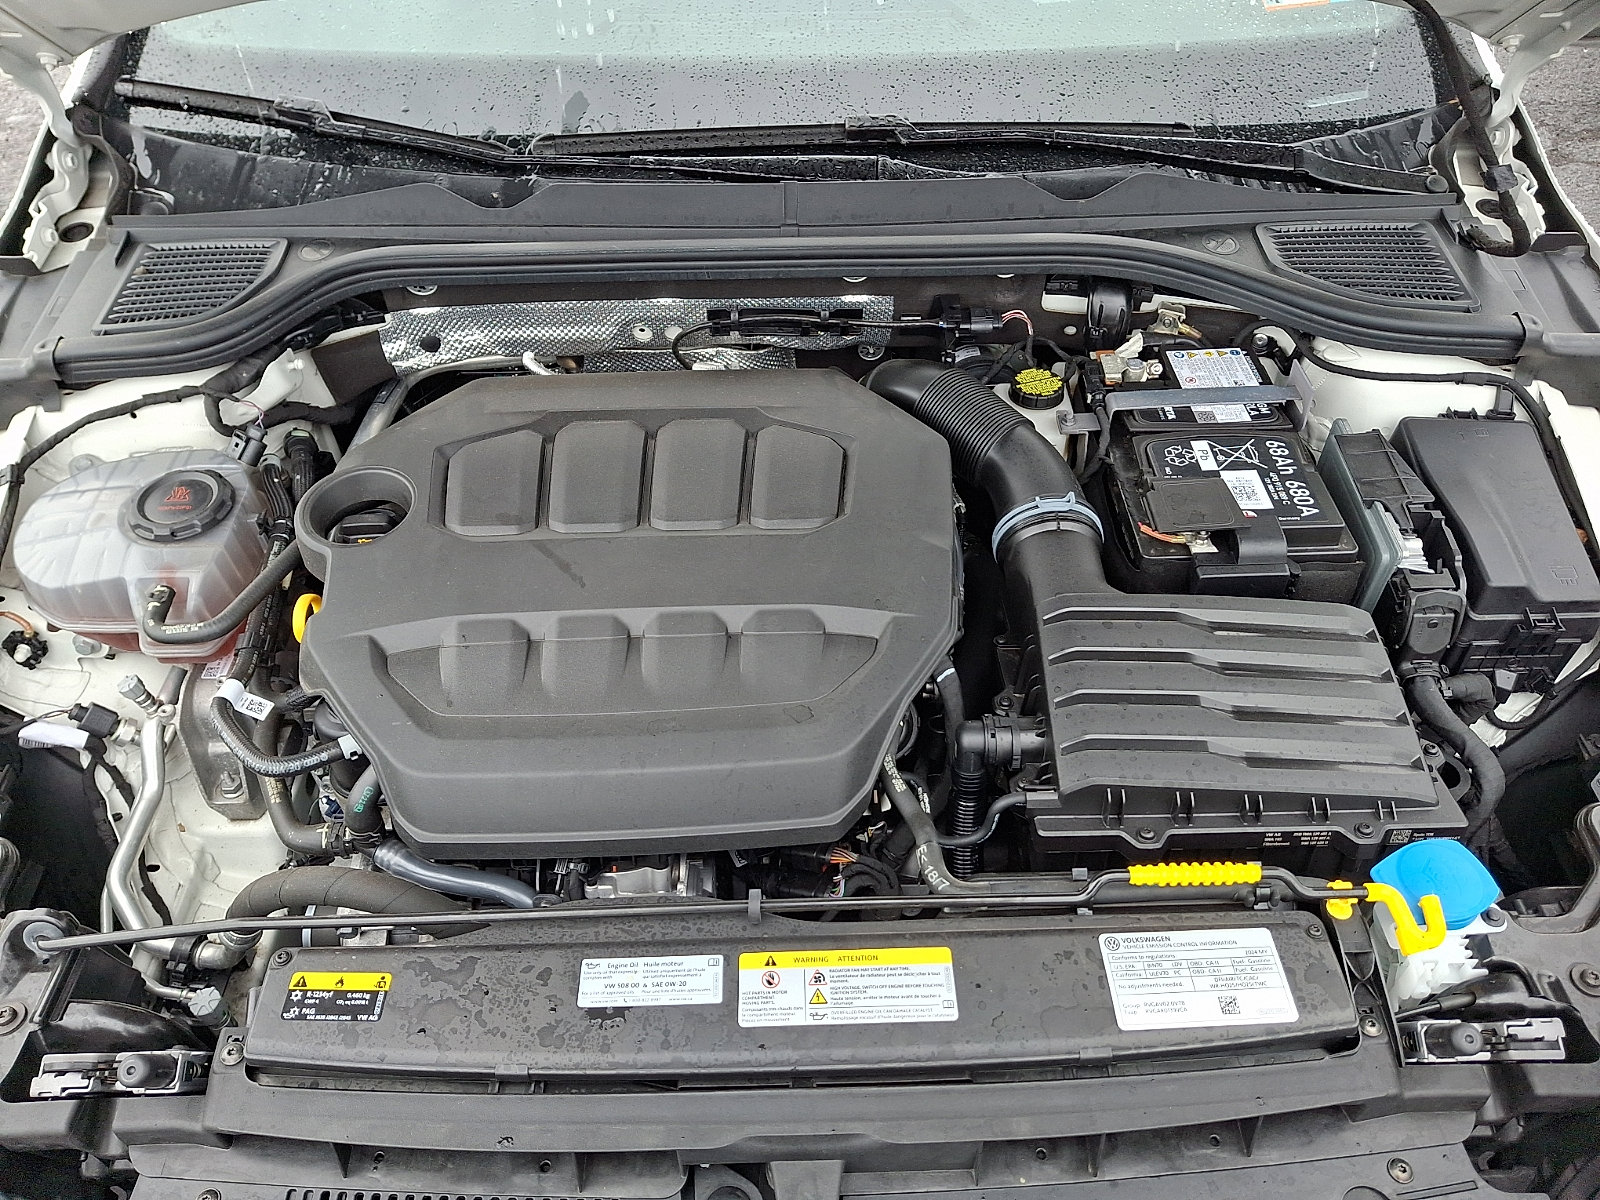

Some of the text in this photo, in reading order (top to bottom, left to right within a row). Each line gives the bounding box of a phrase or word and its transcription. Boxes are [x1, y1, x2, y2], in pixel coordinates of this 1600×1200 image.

[1198, 449, 1210, 461] Pb
[1266, 440, 1320, 516] 68Ah 680A
[306, 991, 334, 999] R-1234yf
